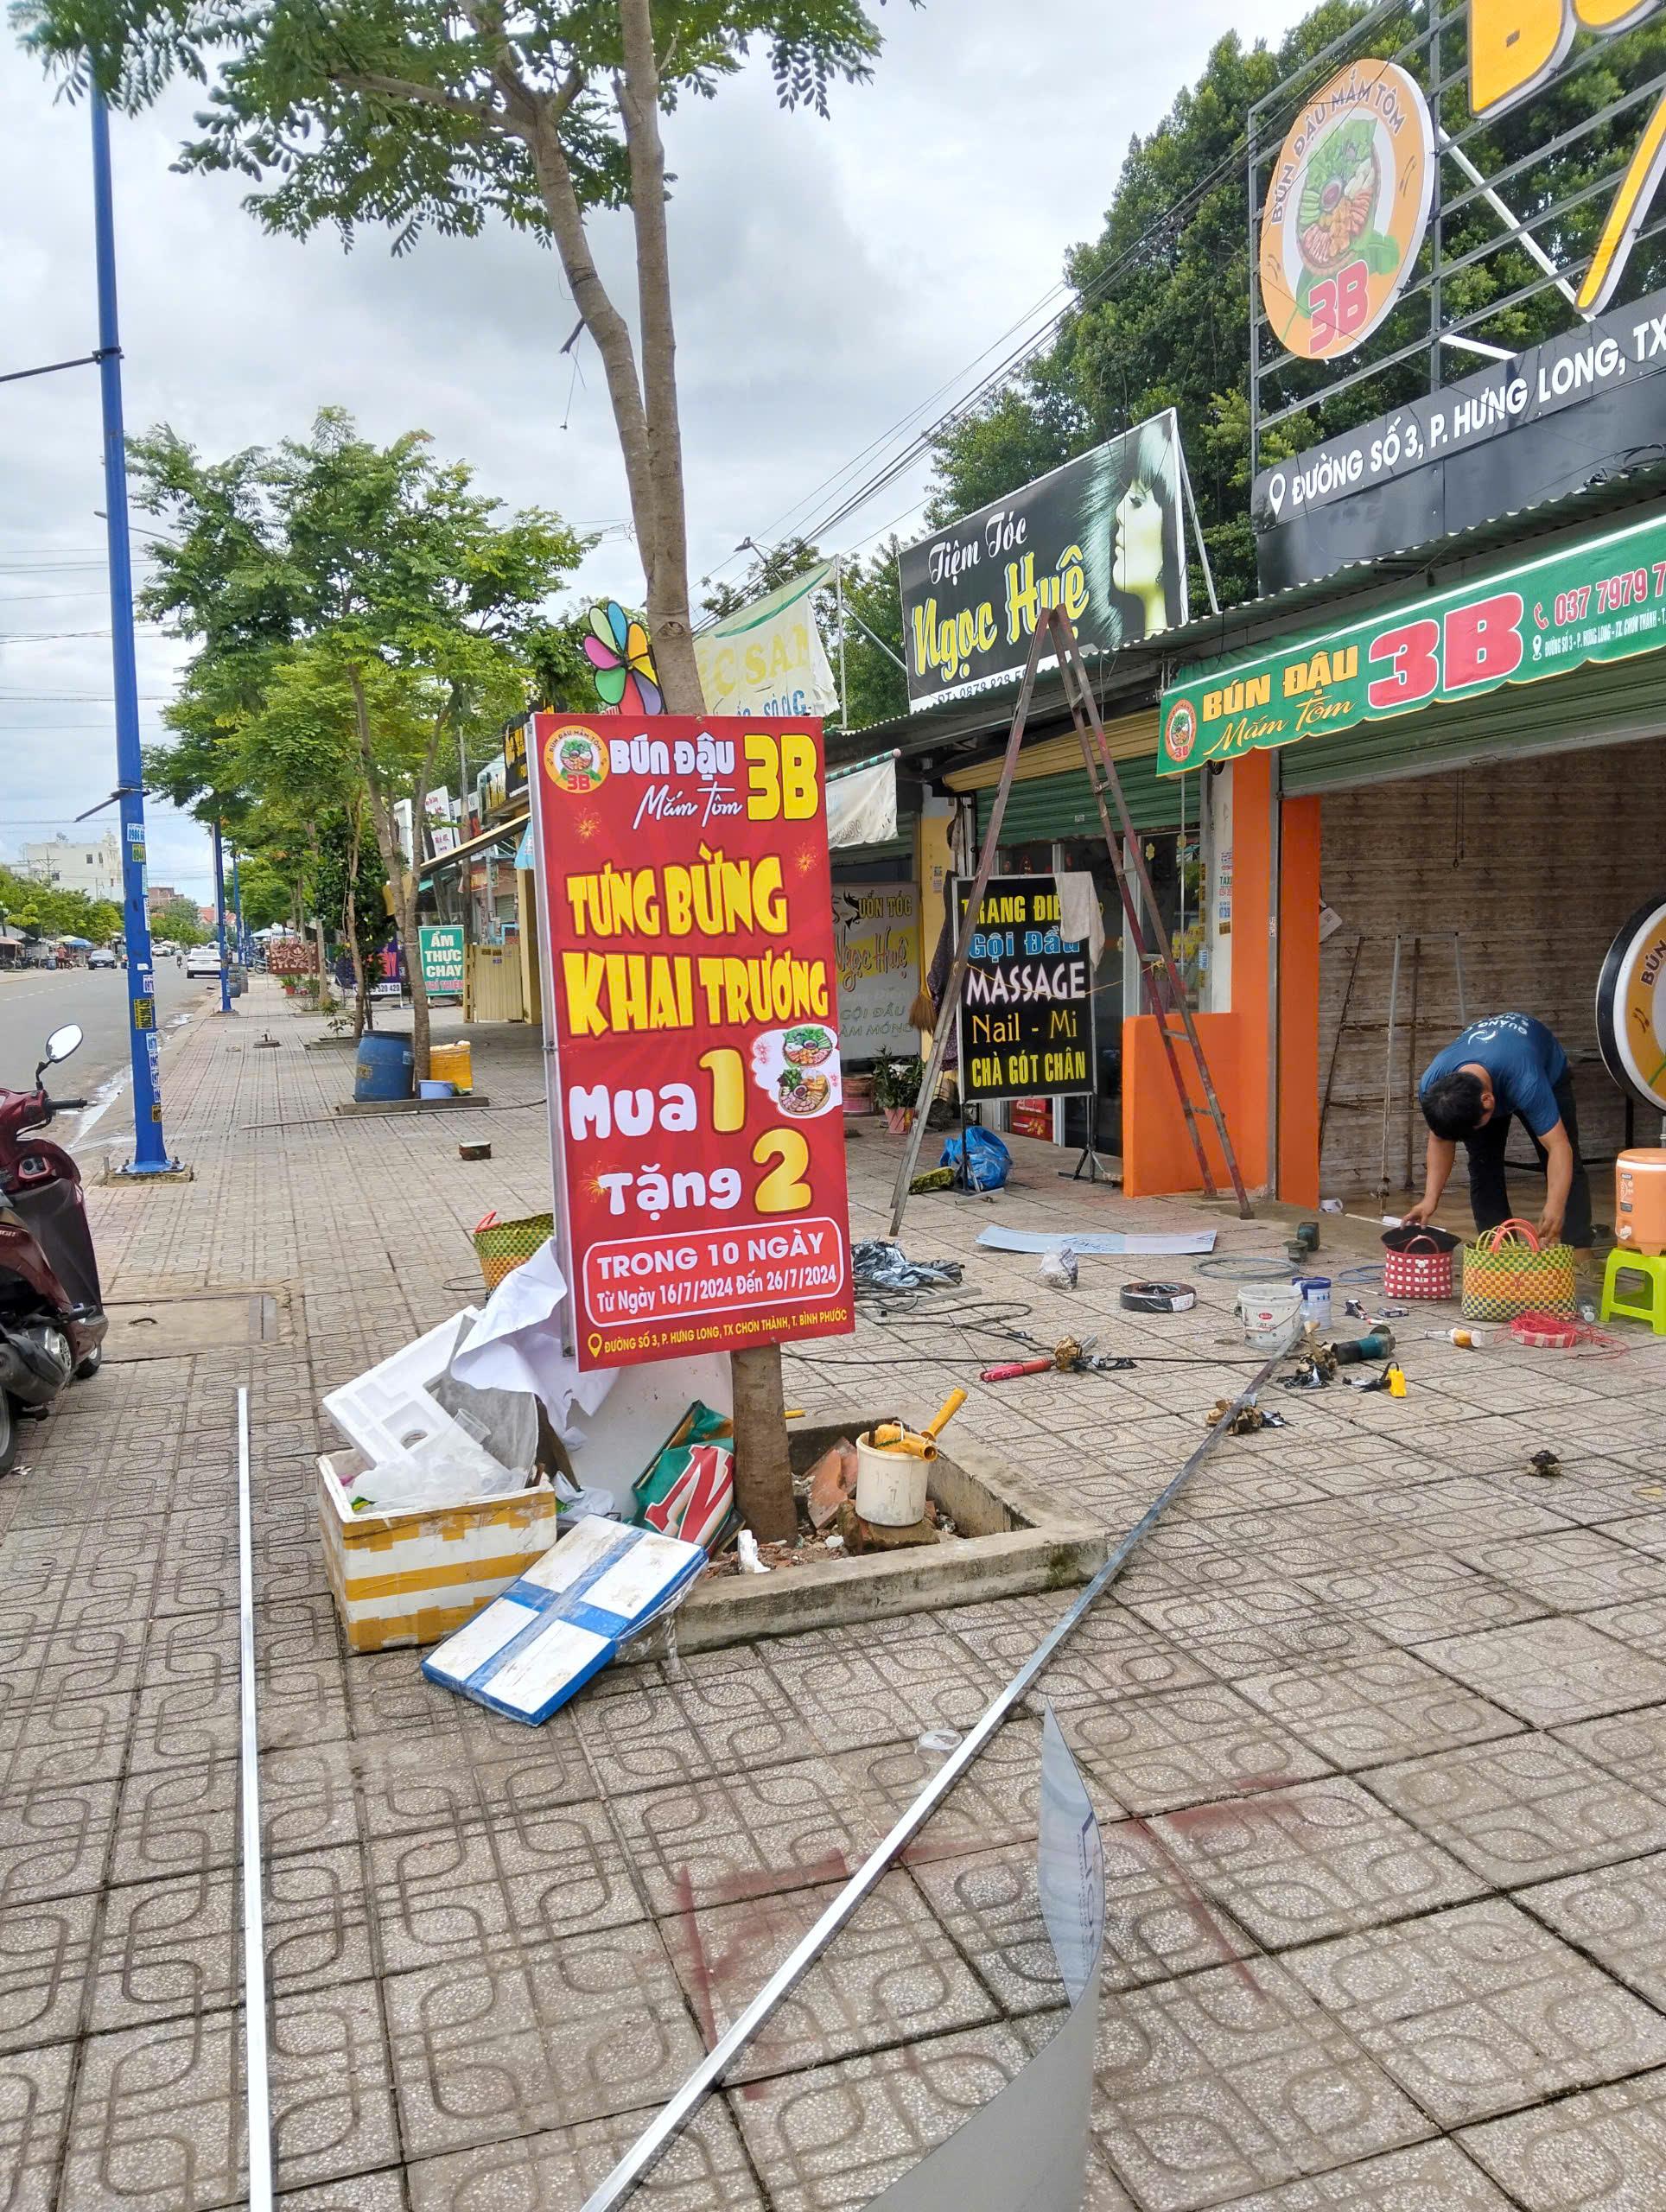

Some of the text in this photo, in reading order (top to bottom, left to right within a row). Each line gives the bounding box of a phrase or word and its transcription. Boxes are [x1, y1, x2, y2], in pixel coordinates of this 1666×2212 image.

[1271, 68, 1406, 224] BÚN ĐẬU MẮM TÔM
[1308, 259, 1369, 355] 3B
[1292, 450, 1363, 505] ĐƯỜNG
[1370, 416, 1402, 474] SỐ
[1405, 425, 1424, 460] 3,
[1430, 414, 1449, 448] P.
[1454, 378, 1528, 435] HƯNG
[1538, 338, 1626, 404] LONG,
[929, 511, 1027, 586] Tiệm Tóc
[912, 544, 1089, 682] Ngọc Huệ
[1555, 585, 1591, 626] 037
[1596, 568, 1648, 614] 7979
[1368, 592, 1523, 710] 3B
[1202, 671, 1270, 722] BÚN
[1282, 644, 1358, 702] ĐẬU
[1203, 715, 1289, 756] Mắm
[1295, 694, 1358, 732] Tôm
[567, 774, 590, 790] 3B
[609, 731, 819, 821] BÚN ĐẬU 3B
[633, 781, 743, 830] Mắm Tôm
[566, 839, 788, 937] TƯNG BỪNG
[886, 890, 912, 918] TÓC
[424, 950, 461, 965] THỰC
[426, 965, 461, 977] CHAY
[874, 925, 909, 979] Huệ
[969, 932, 1014, 963] Gội
[562, 948, 829, 1036] KHAI TRƯƠNG
[966, 962, 1086, 1007] MASSAGE
[839, 1024, 862, 1037] ÀM
[972, 1012, 1021, 1044] Nail
[1050, 1009, 1078, 1039] Mi
[569, 1046, 747, 1141] Mua 1
[972, 1046, 1086, 1088] CHÀ GÓT CHÂN
[597, 1127, 811, 1220] Tặng 2
[596, 1229, 824, 1280] TRONG 10 NGÀY
[596, 1264, 836, 1314] Từ Ngày 16/7/2024 Đến 26/7/2024
[604, 1307, 847, 1354] ĐƯỜNG SỐ 3, P. HƯNG LONG, TX CHƠN THÀNH, T. BÌNH PHƯỚC
